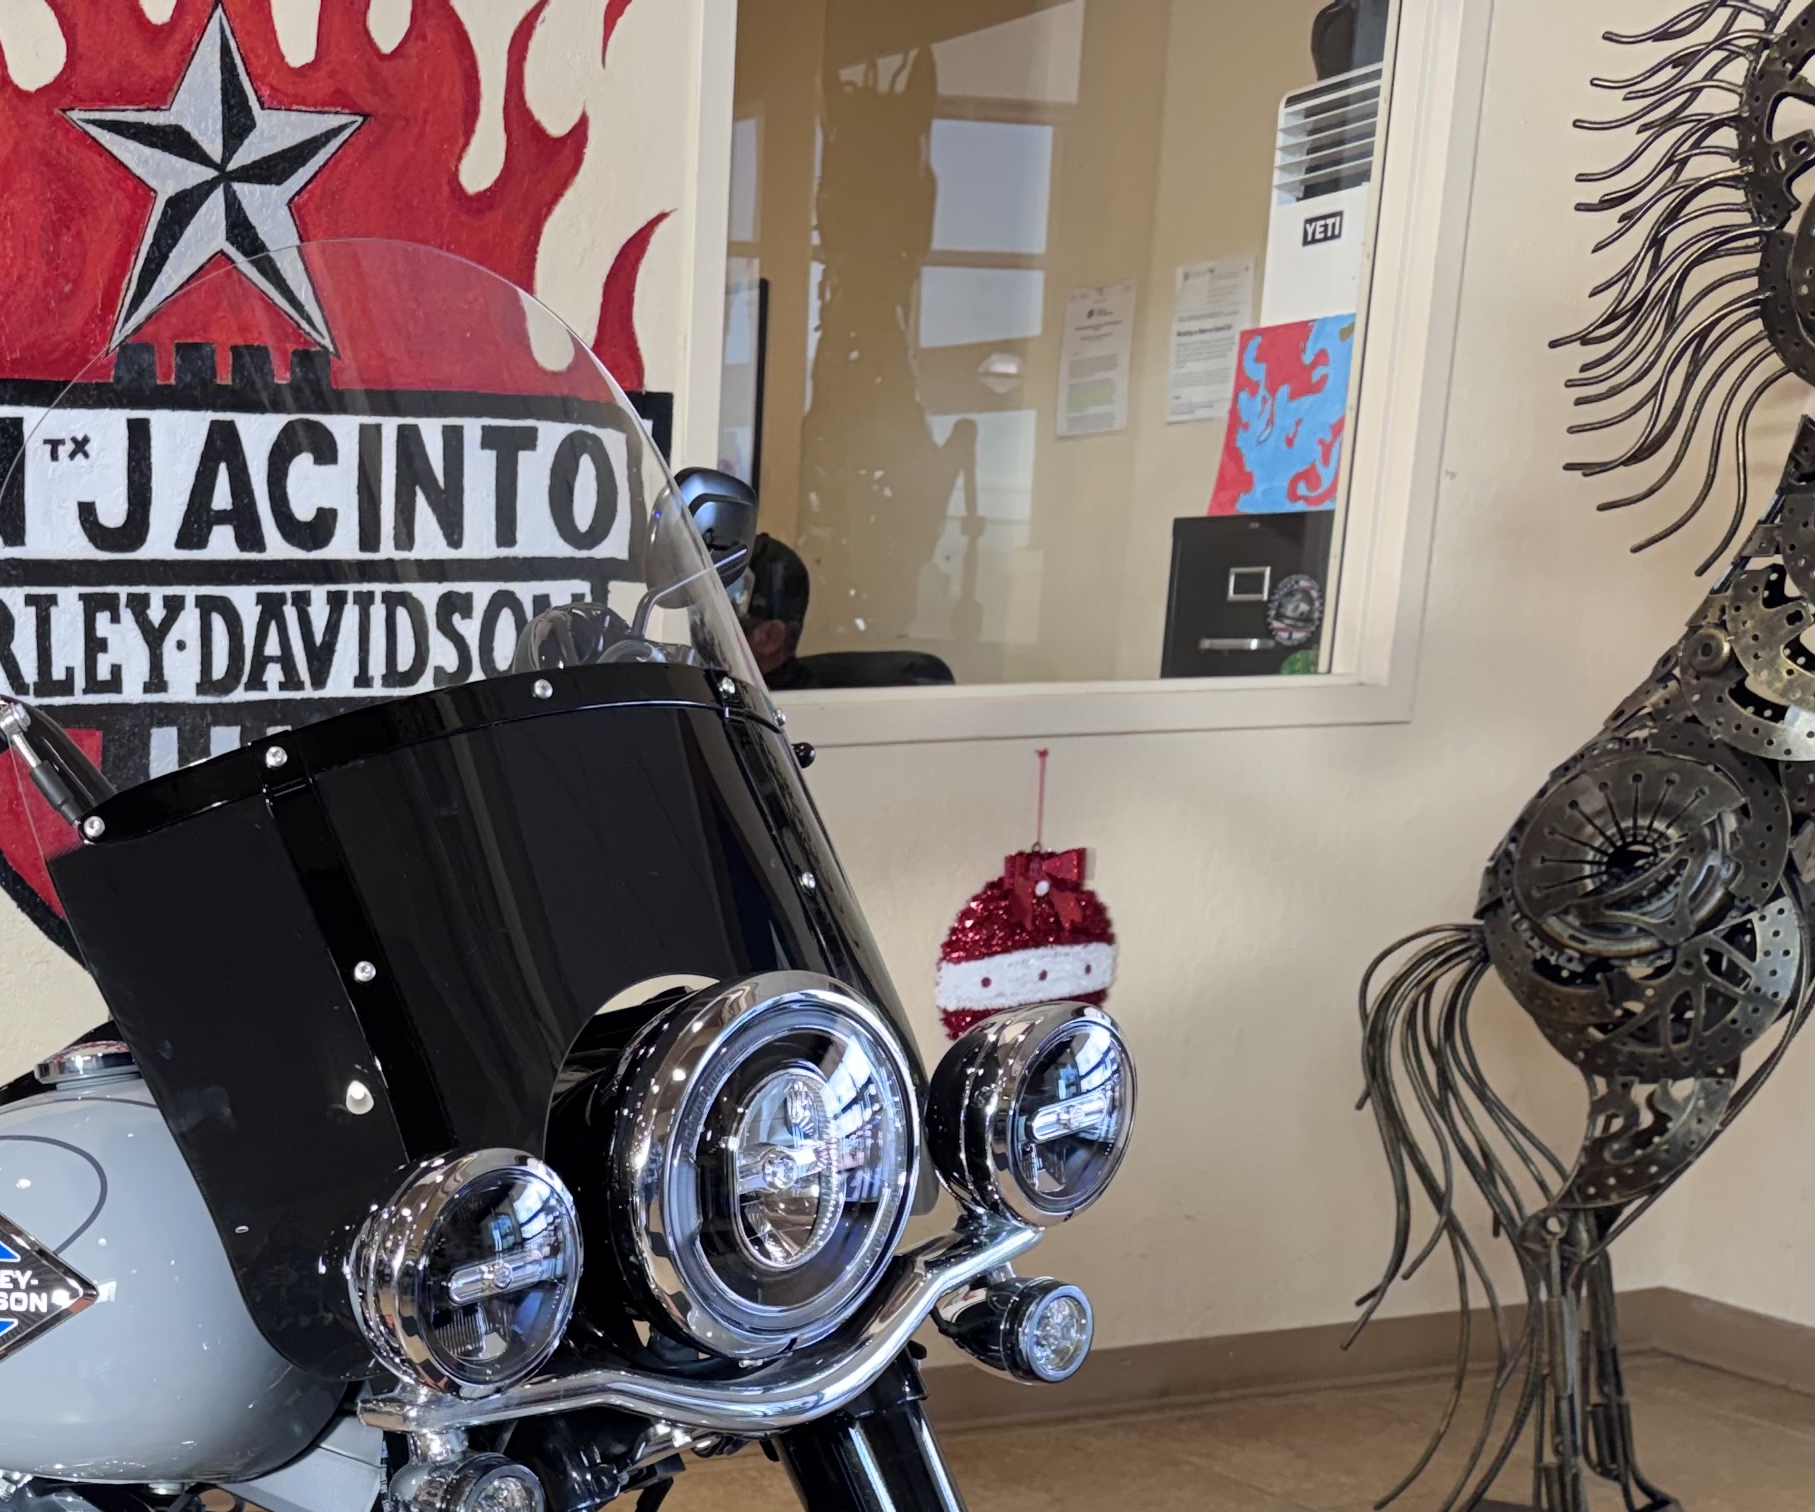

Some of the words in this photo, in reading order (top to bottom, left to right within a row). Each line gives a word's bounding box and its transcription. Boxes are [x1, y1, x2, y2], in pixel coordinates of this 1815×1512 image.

[1306, 216, 1341, 242] YETI
[43, 434, 91, 463] TX
[78, 416, 619, 553] JACINTO
